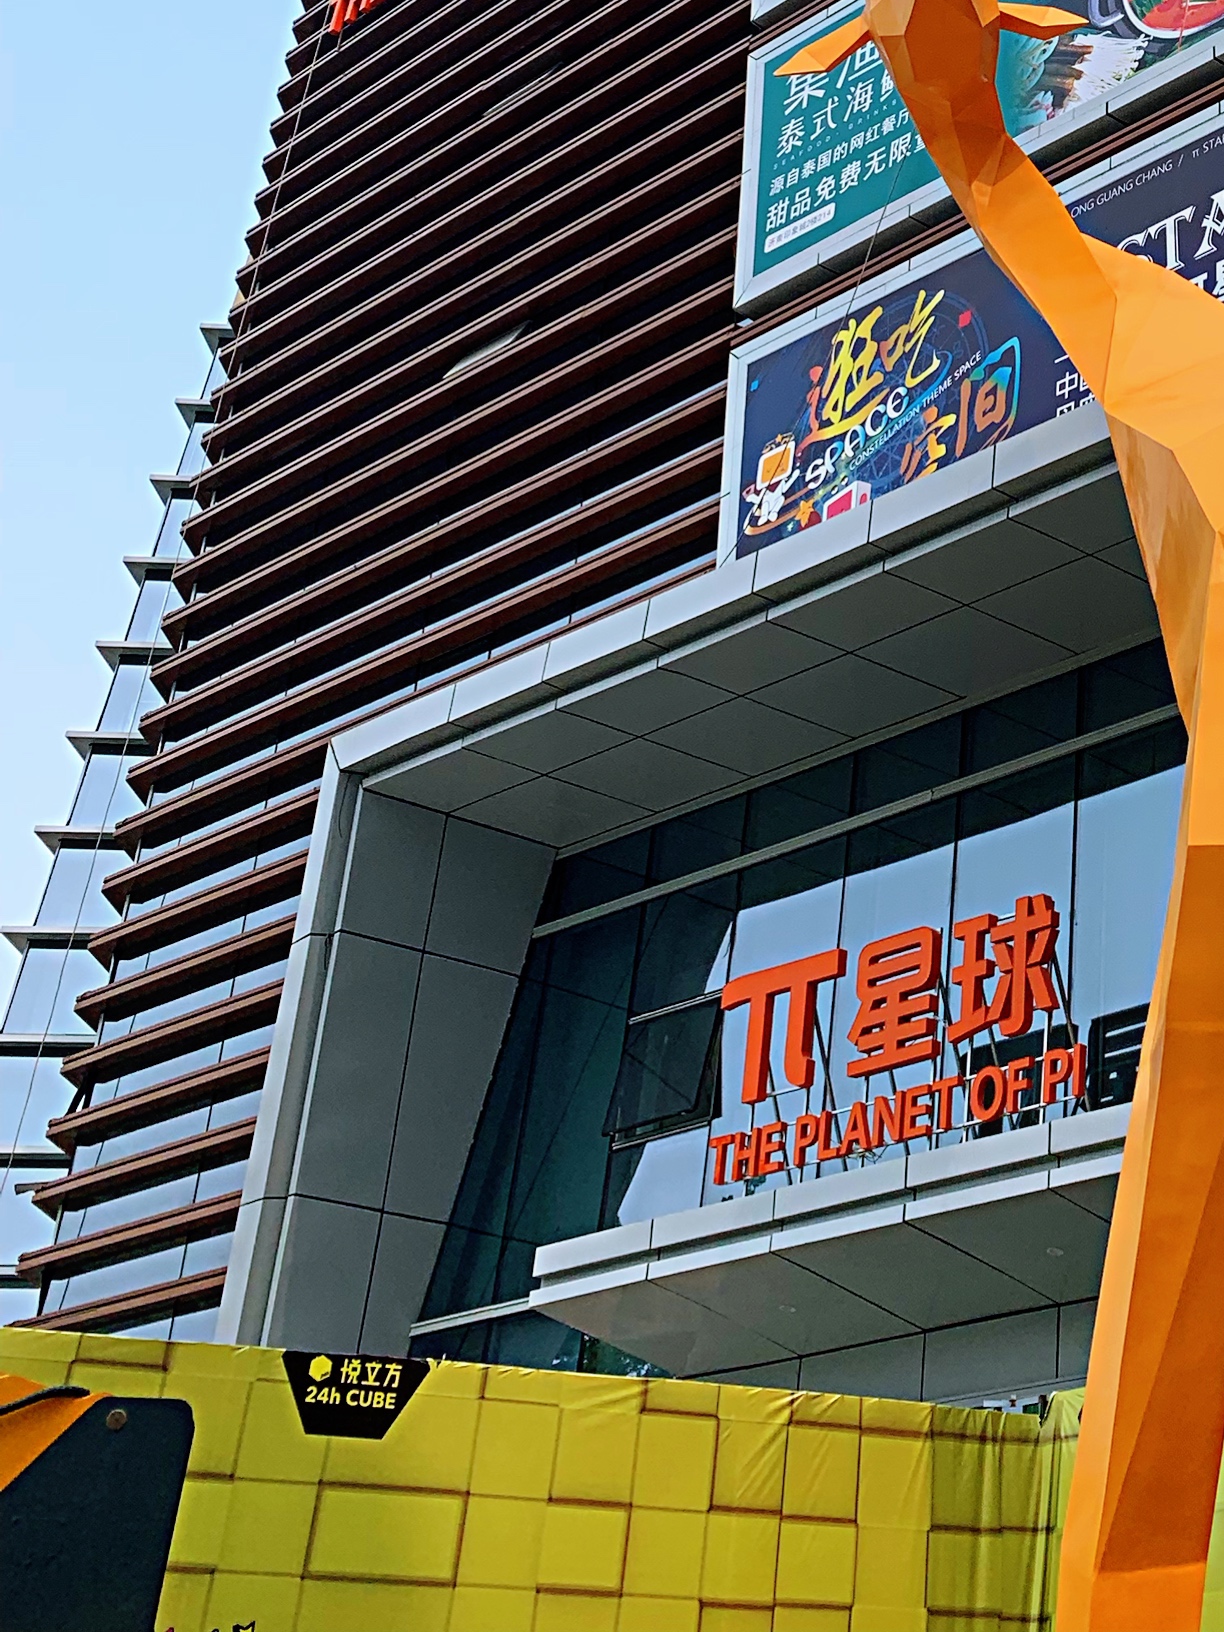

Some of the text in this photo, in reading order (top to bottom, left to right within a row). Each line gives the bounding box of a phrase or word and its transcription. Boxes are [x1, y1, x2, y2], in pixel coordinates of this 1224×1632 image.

[1096, 180, 1134, 205] GUANG
[1135, 159, 1174, 186] CHANG
[804, 386, 909, 490] SPACE
[848, 349, 983, 471] CONSTELLATION THEME SPACE
[710, 1042, 1087, 1185] THE PLANET OF PI
[304, 1385, 397, 1410] 24h CUBE
[340, 1358, 403, 1388] 悦立方
